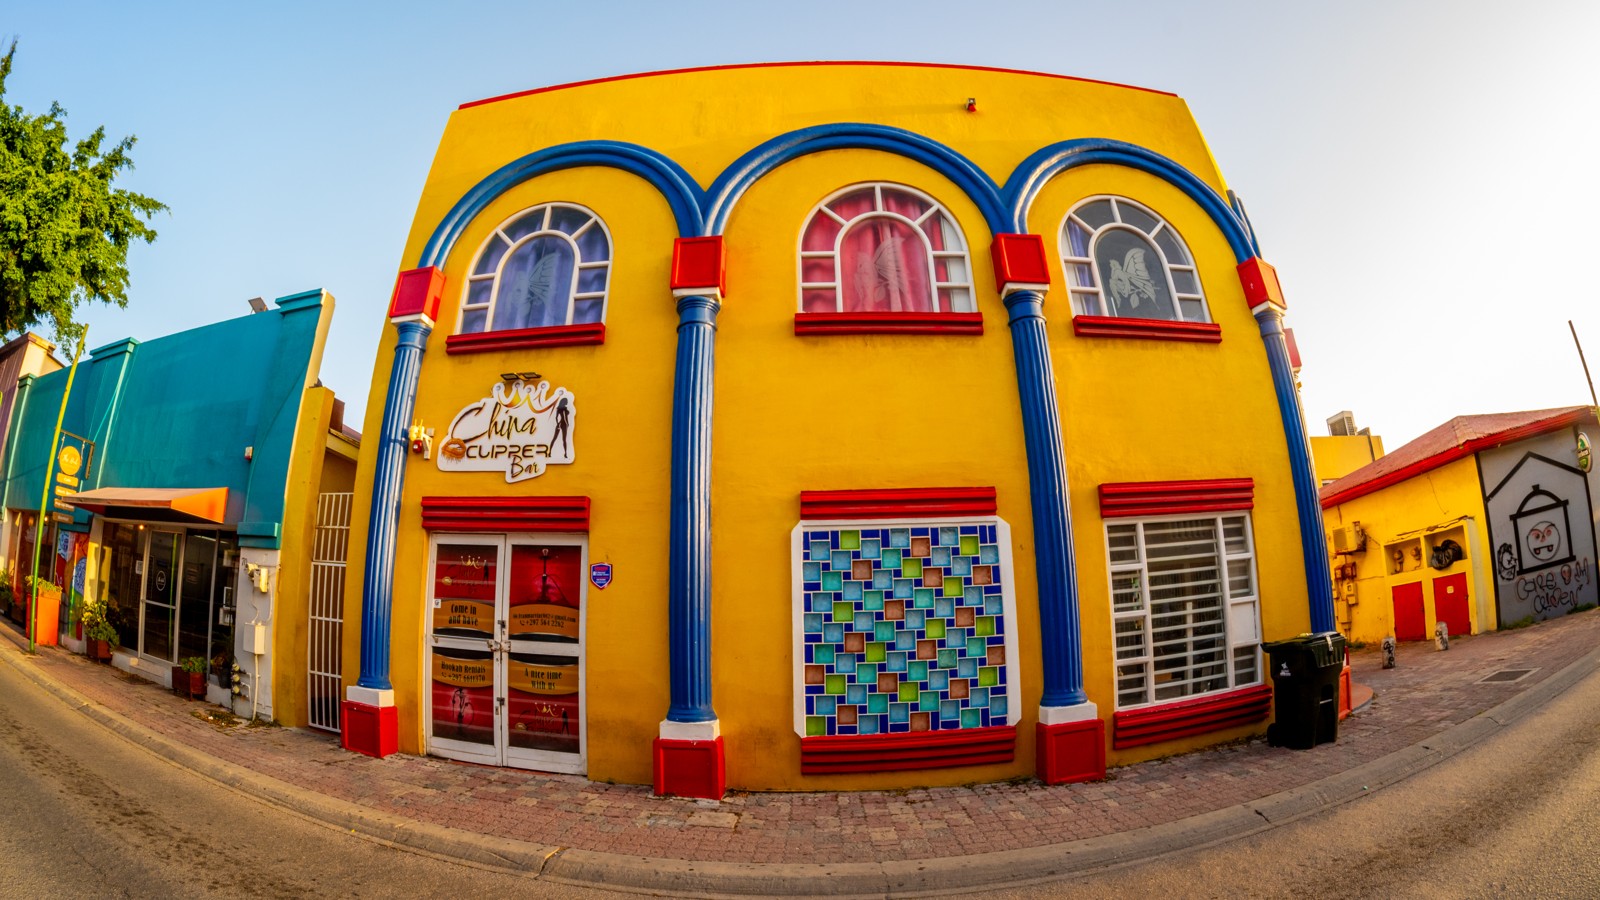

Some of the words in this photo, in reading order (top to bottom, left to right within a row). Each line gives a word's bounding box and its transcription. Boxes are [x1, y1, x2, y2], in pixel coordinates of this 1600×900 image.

[451, 402, 536, 443] China
[511, 455, 539, 479] Bar
[451, 603, 468, 613] Come
[470, 605, 477, 615] in
[448, 614, 461, 624] and
[462, 615, 479, 626] have
[441, 661, 462, 673] Hookah
[464, 664, 486, 673] Rentals
[530, 670, 545, 679] nice
[546, 671, 563, 680] time
[531, 680, 546, 690] with
[547, 682, 556, 690] us
